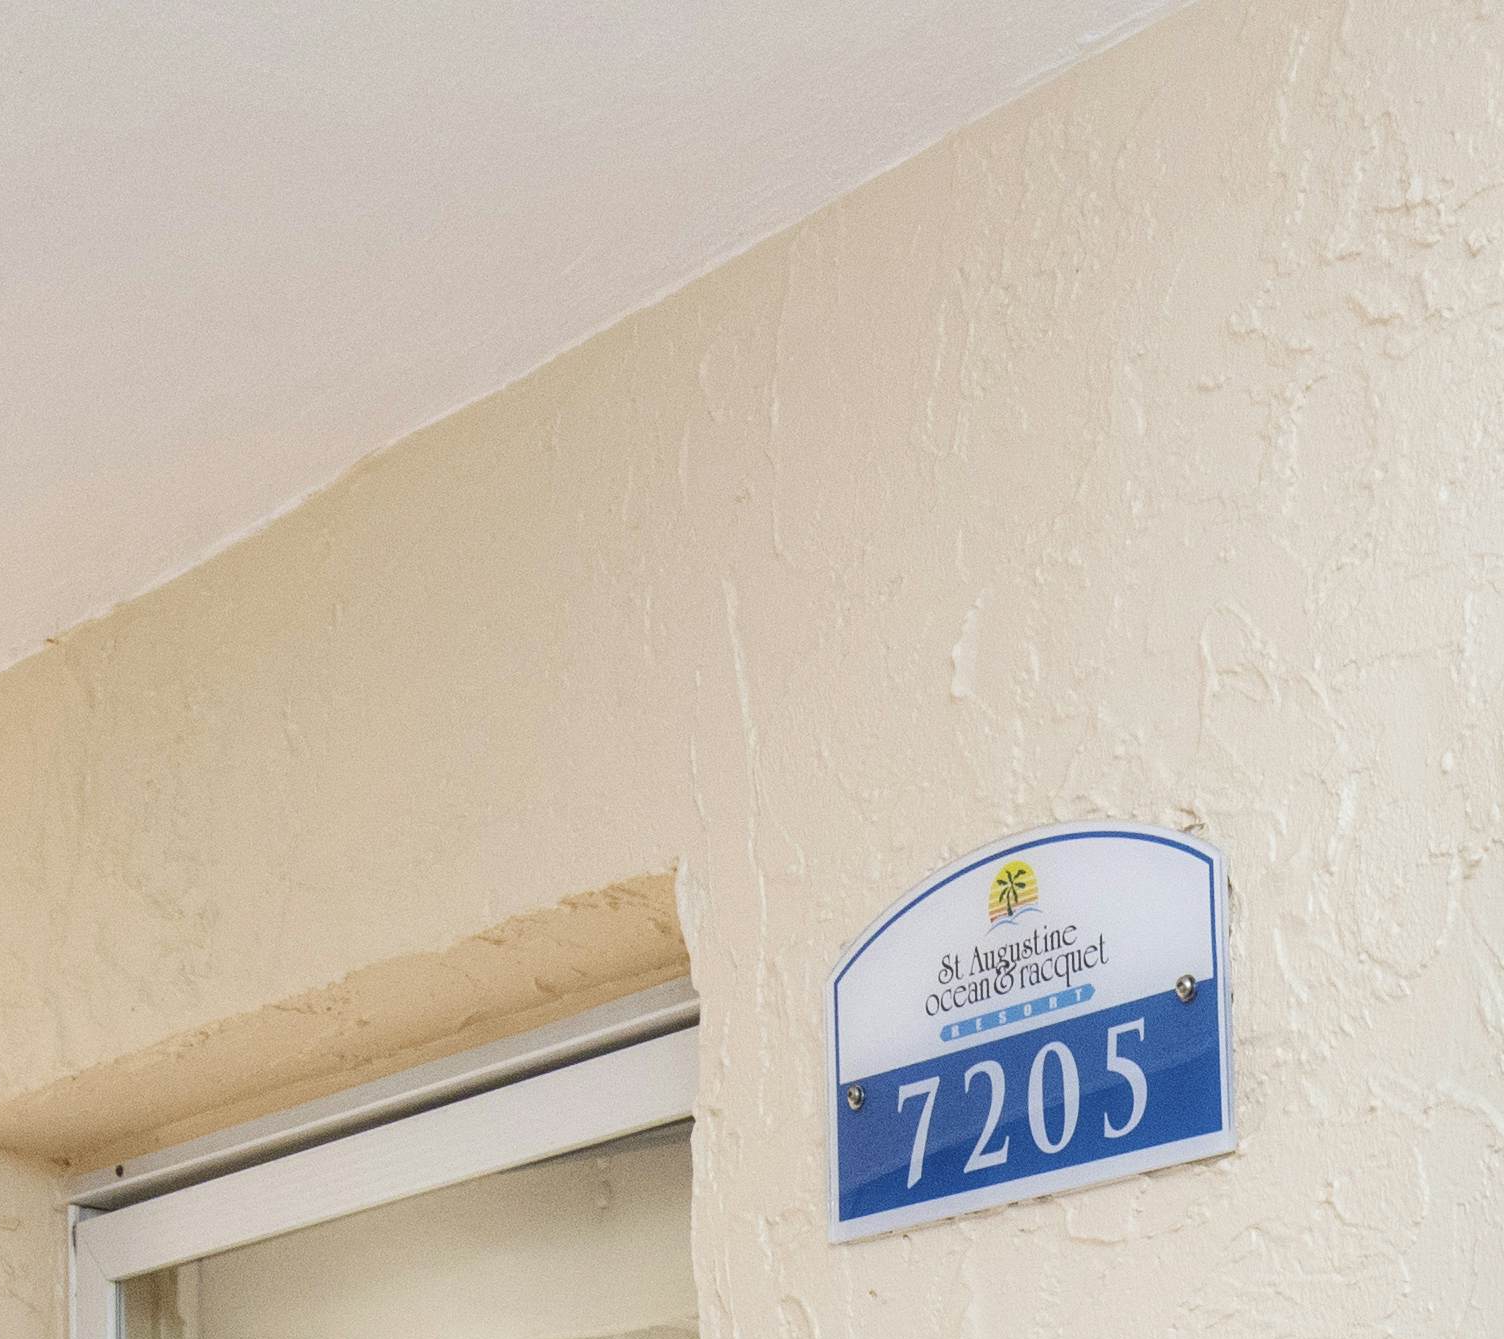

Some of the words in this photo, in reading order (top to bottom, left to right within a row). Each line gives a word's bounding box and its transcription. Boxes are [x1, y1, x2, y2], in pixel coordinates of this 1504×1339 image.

[925, 976, 991, 1016] ocean
[1019, 933, 1109, 988] racquet
[938, 952, 964, 985] St
[968, 924, 1078, 977] Augustine
[950, 988, 1084, 1038] RESORT
[897, 1017, 1149, 1189] 7205
